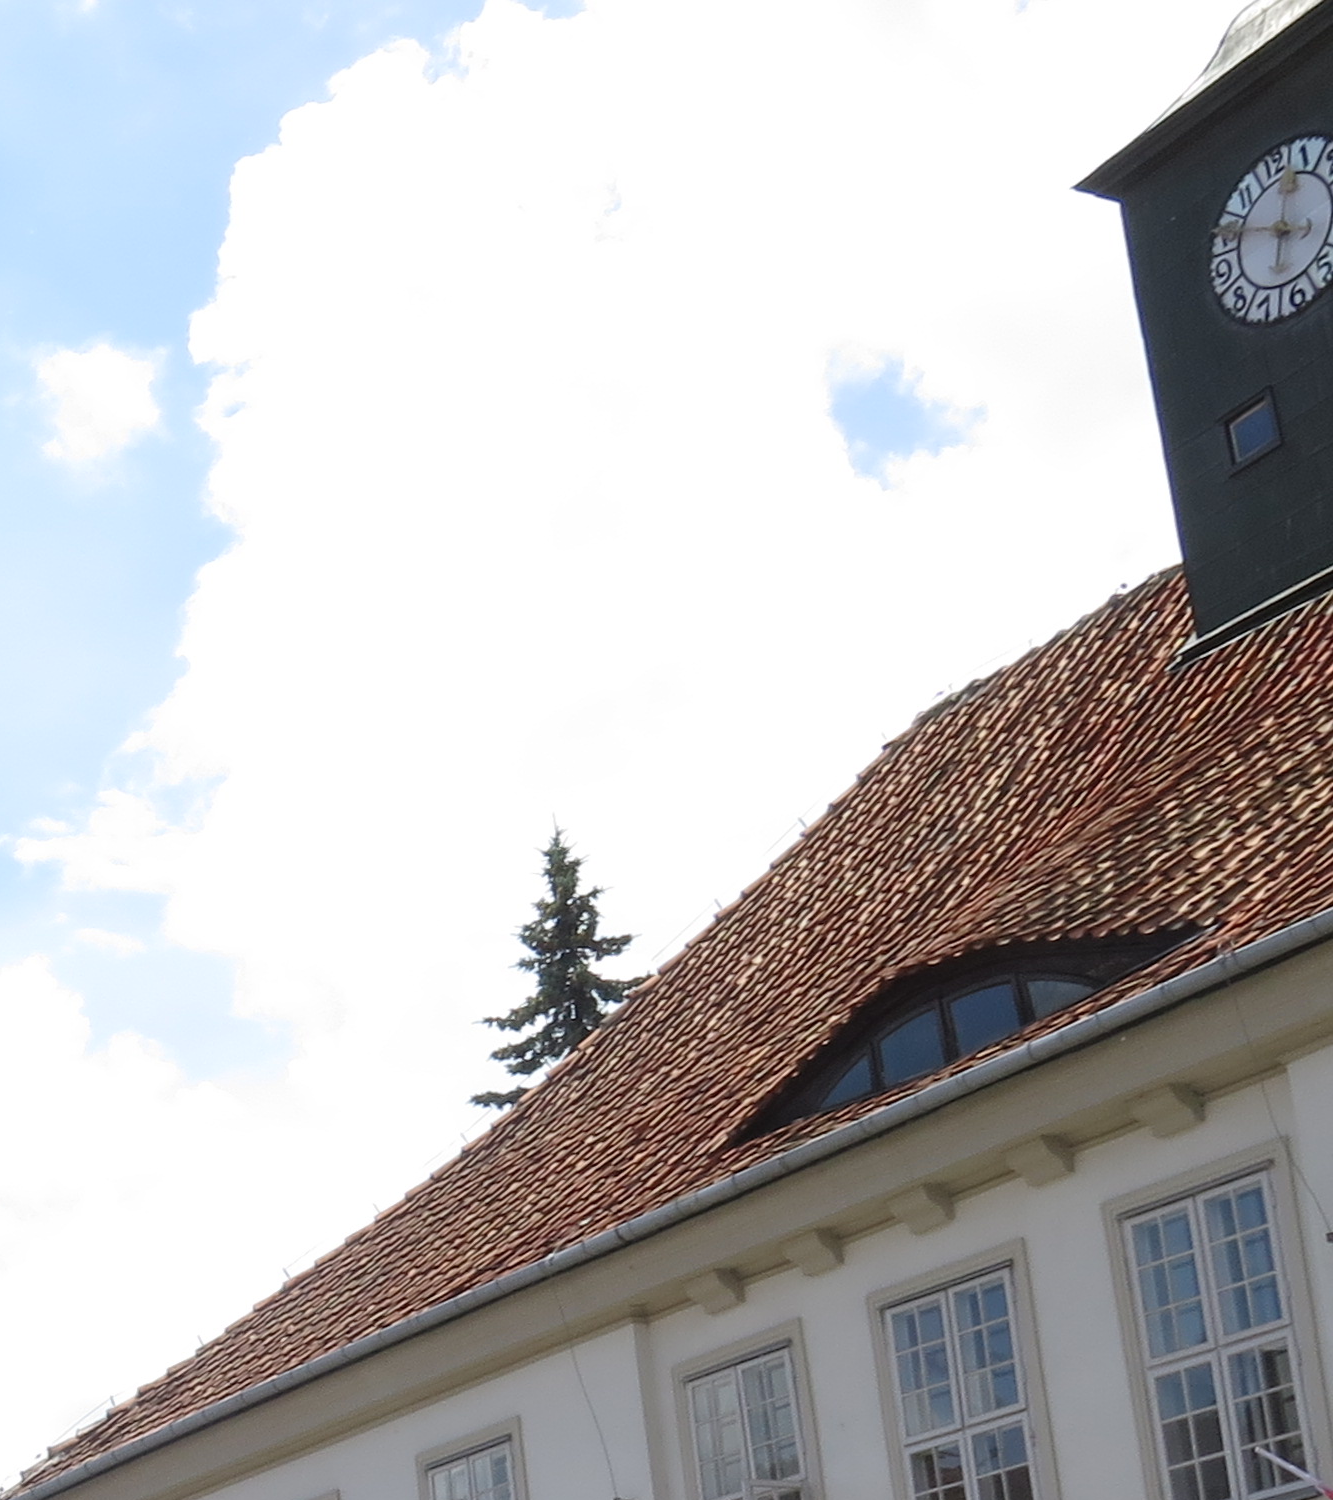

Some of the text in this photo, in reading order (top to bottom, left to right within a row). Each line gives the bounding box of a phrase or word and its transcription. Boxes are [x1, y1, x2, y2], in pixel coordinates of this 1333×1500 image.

[1263, 151, 1285, 180] 12
[1299, 144, 1309, 170] 1
[1240, 183, 1253, 210] 11
[1215, 258, 1232, 285] 9
[1234, 285, 1247, 312] 8
[1257, 293, 1270, 321] 7
[1288, 282, 1306, 307] 6
